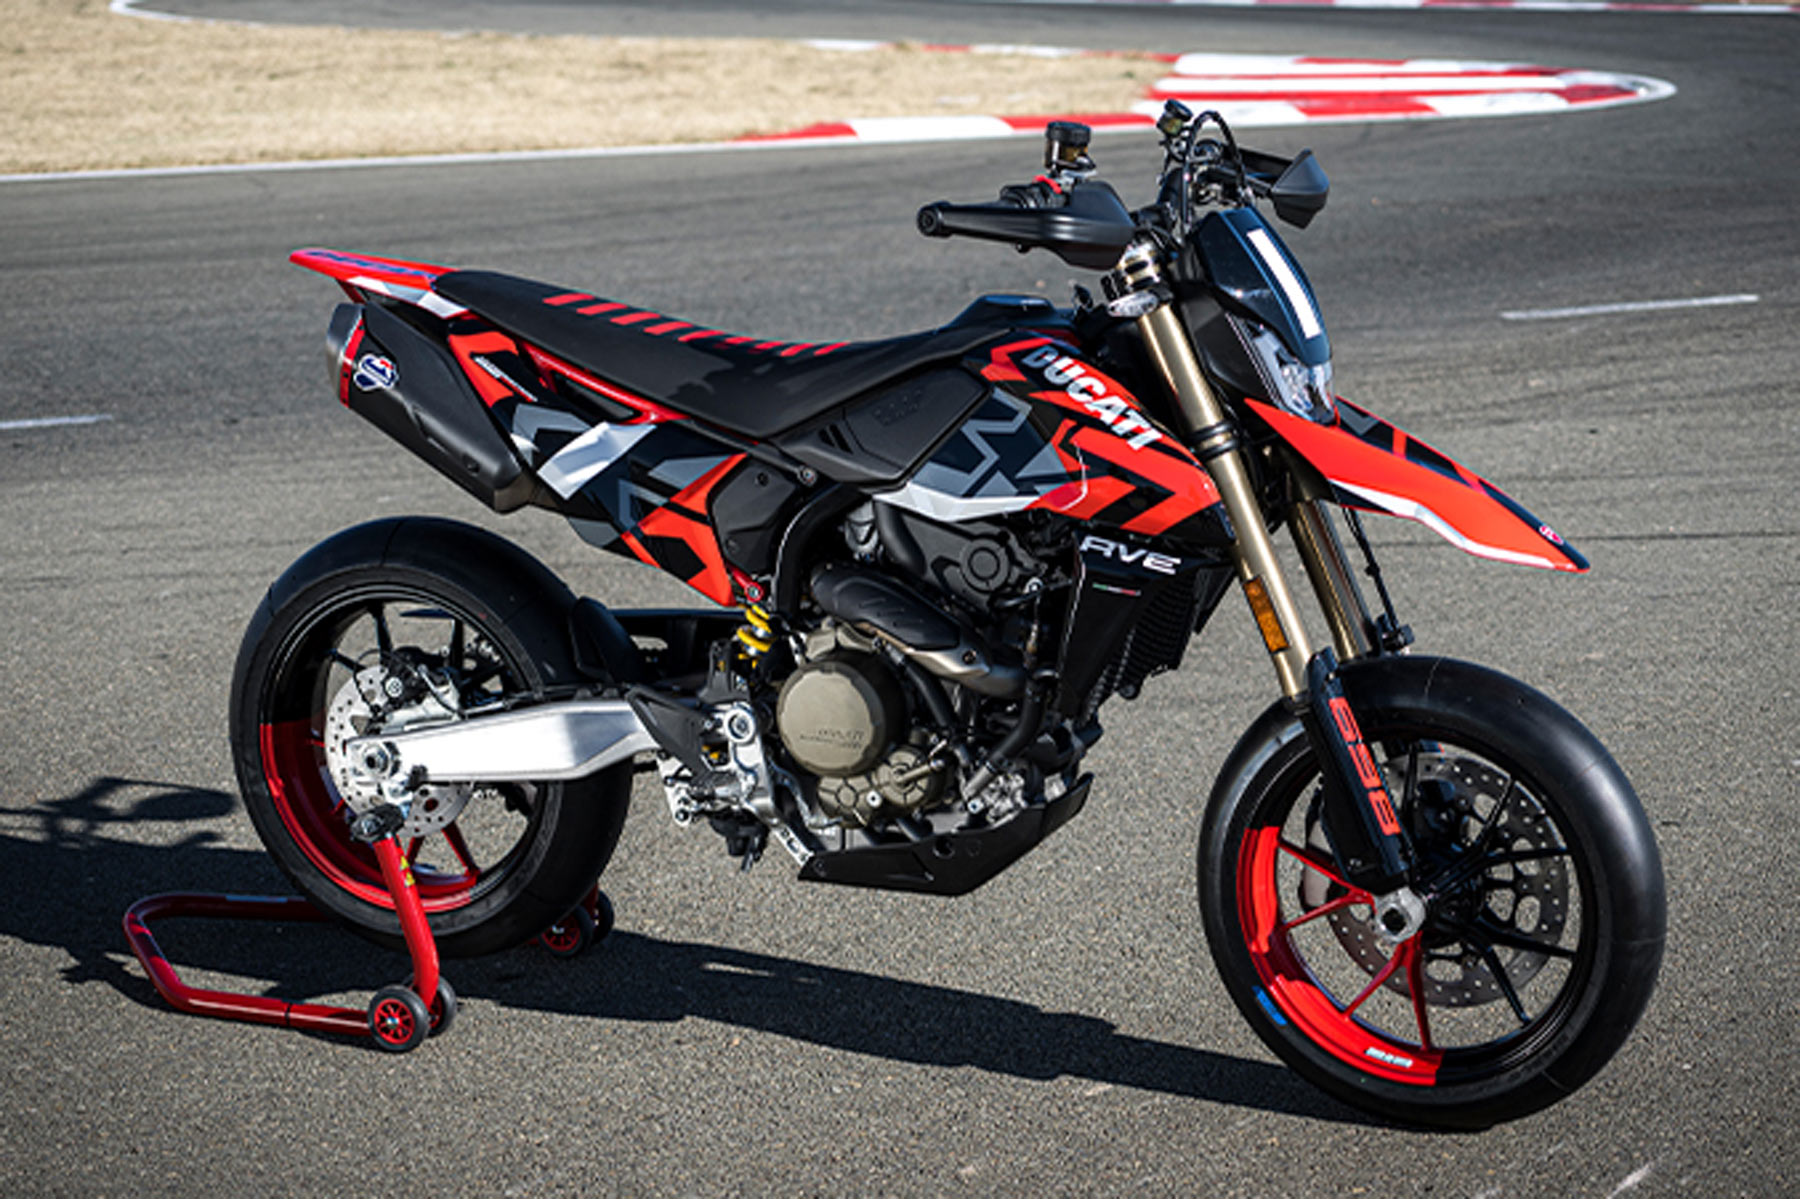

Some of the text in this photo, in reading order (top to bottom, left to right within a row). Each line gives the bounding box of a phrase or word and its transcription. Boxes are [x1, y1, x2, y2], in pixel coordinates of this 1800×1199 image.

[1021, 344, 1163, 451] DUCATI
[1080, 535, 1181, 575] RVE
[1328, 696, 1402, 836] 698
